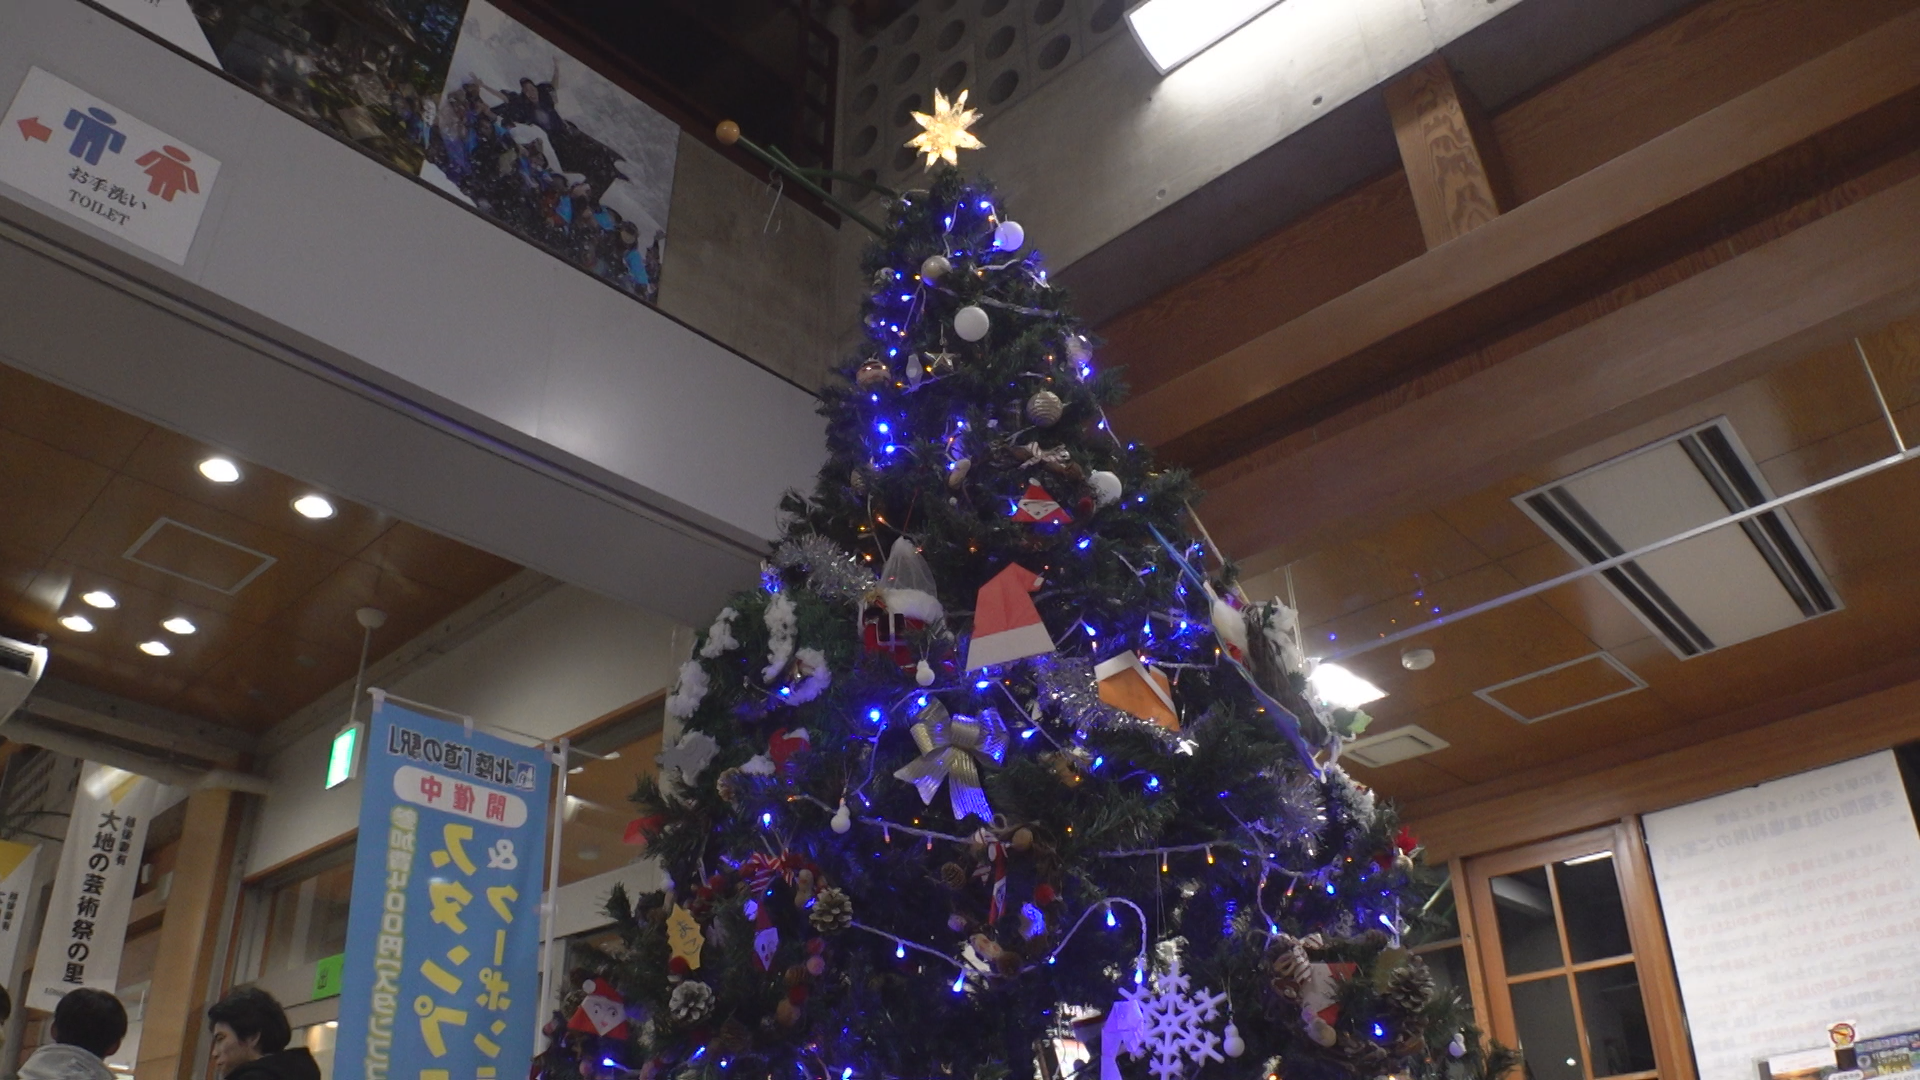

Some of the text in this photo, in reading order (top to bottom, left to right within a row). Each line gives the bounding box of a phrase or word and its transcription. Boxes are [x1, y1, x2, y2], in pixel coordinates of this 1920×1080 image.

[68, 166, 147, 210] お手洗い
[68, 189, 130, 226] TOILET
[62, 809, 122, 984] 大地の芸術祭の里
